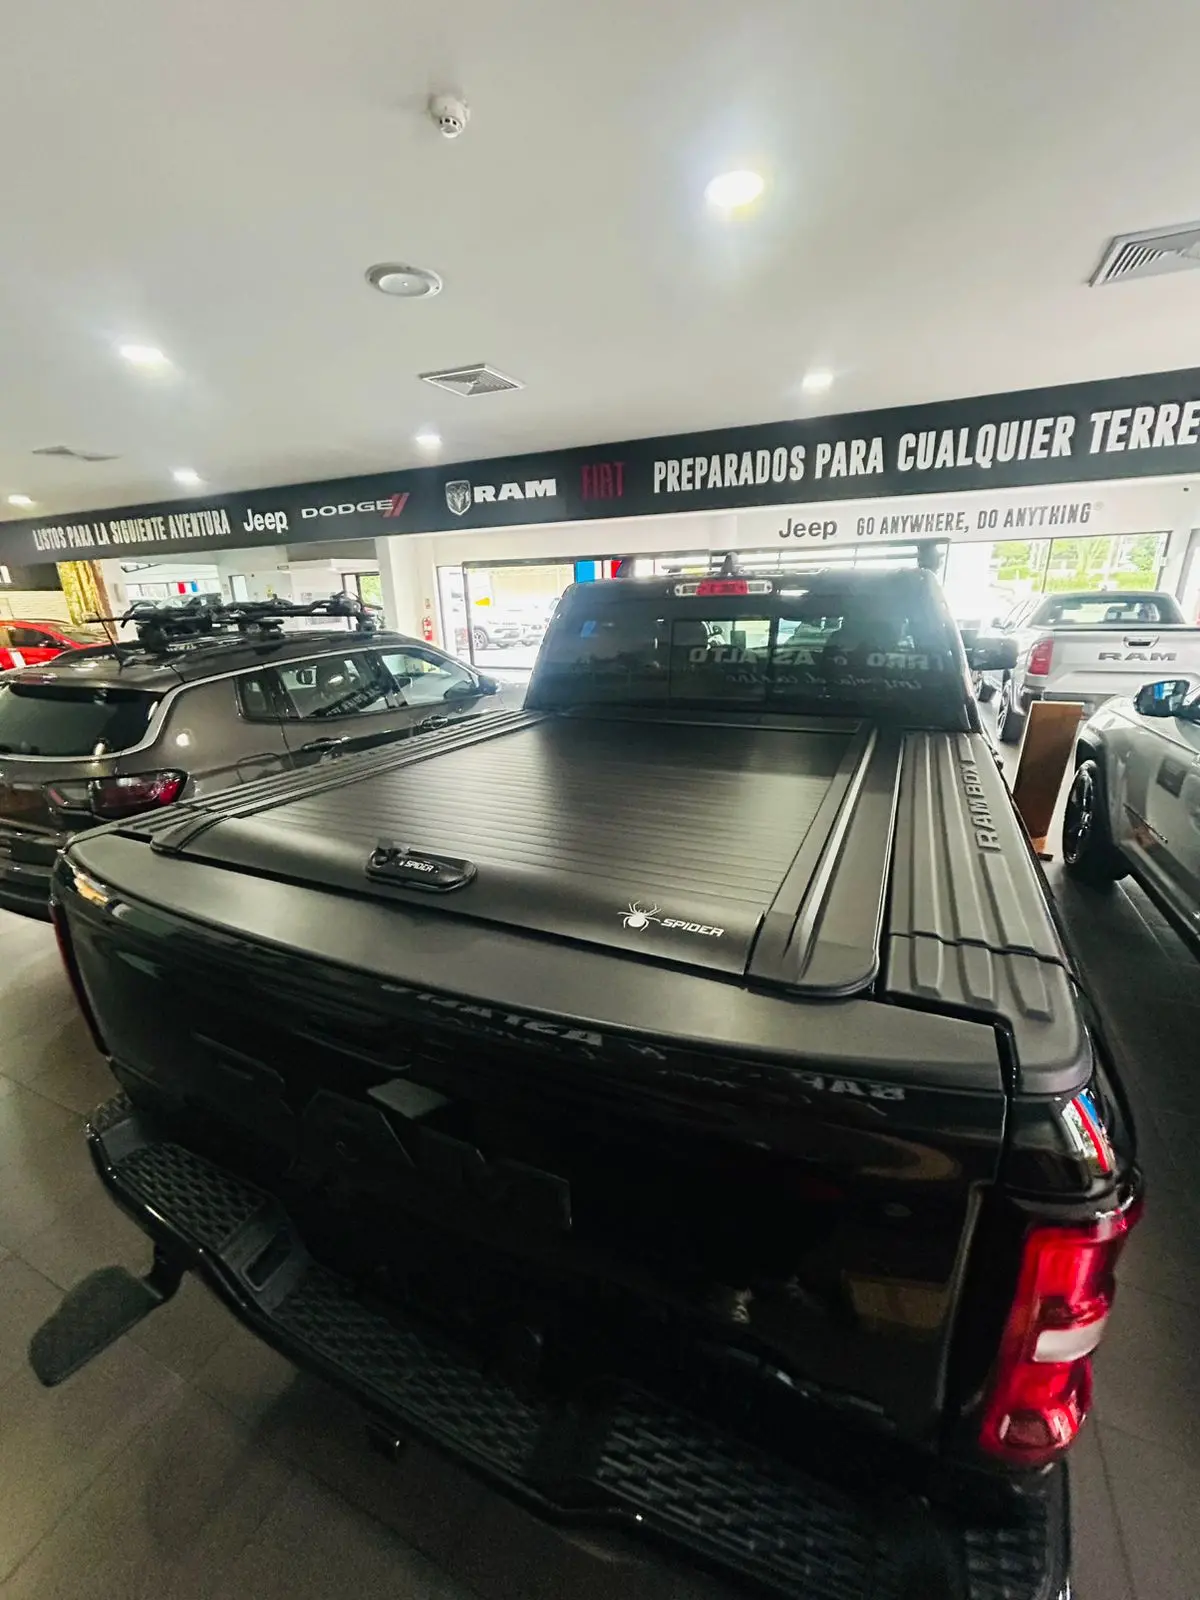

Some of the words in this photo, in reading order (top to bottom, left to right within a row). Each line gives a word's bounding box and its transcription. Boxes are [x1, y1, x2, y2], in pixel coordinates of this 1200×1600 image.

[653, 444, 805, 494] PREPARADOS
[815, 436, 884, 480] PARA
[897, 414, 1076, 472] CUALQUIER
[1089, 400, 1200, 455] TERRE
[473, 478, 557, 503] RAM
[581, 461, 626, 499] FIAT
[243, 508, 289, 534] Jeep
[301, 499, 395, 519] DODGE
[778, 518, 838, 541] Jeep
[856, 516, 875, 537] GO
[879, 511, 970, 535] ANYWHERE,
[977, 509, 999, 530] DO
[1003, 502, 1092, 528] ANYTHING
[32, 525, 68, 551] LISTOS
[66, 523, 96, 548] PARA
[93, 522, 111, 546] LA
[109, 516, 167, 545] SIGUIENTE
[168, 509, 231, 540] AVENTURA
[1098, 652, 1177, 662] RAM
[959, 760, 1001, 851] RAMBOX
[403, 860, 435, 873] SPIDER
[660, 918, 725, 938] SPIDER
